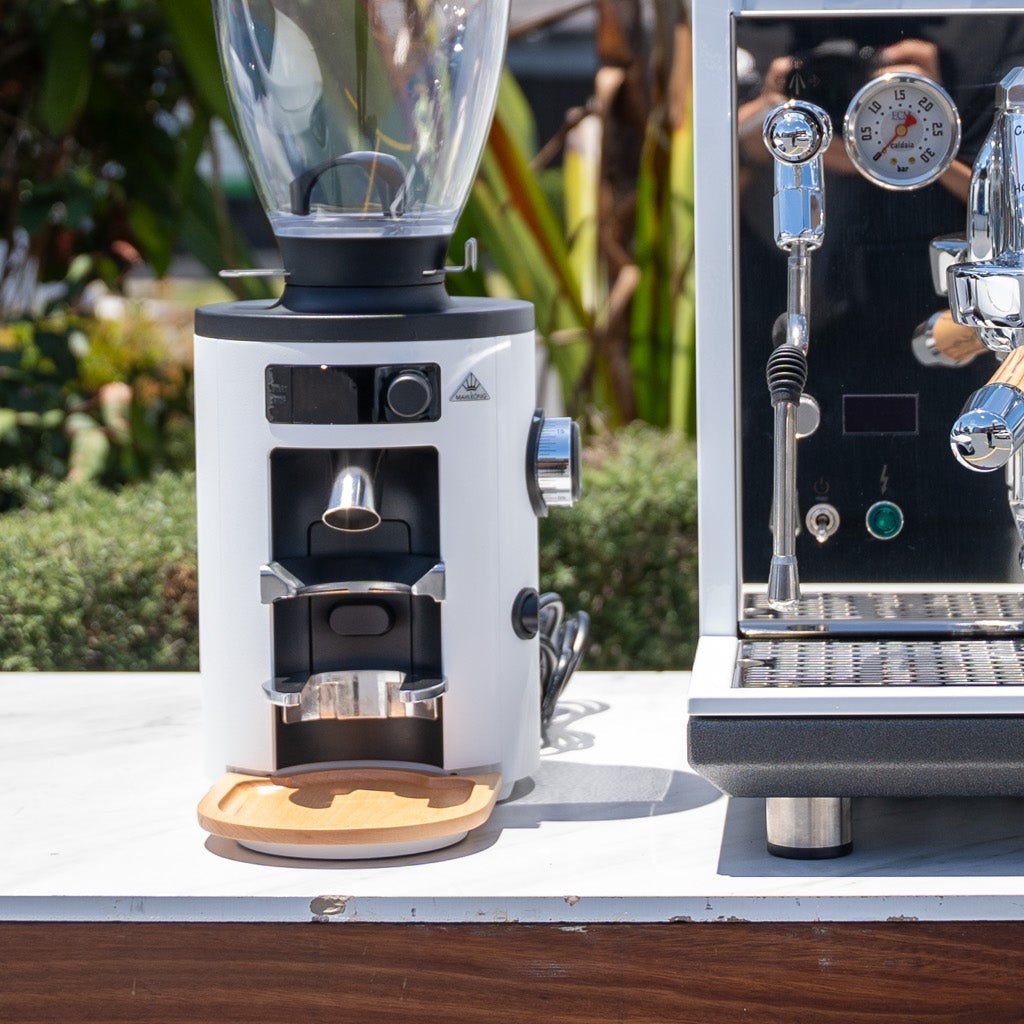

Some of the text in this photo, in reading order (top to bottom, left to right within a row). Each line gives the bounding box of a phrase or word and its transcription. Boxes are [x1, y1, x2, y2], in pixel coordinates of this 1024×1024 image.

[894, 89, 906, 101] 1.5
[868, 100, 882, 114] 1.0
[918, 97, 933, 112] 2.0
[860, 126, 872, 141] 0.5
[932, 122, 943, 137] 2.5
[890, 140, 915, 149] caldaia
[920, 148, 935, 163] 3.0
